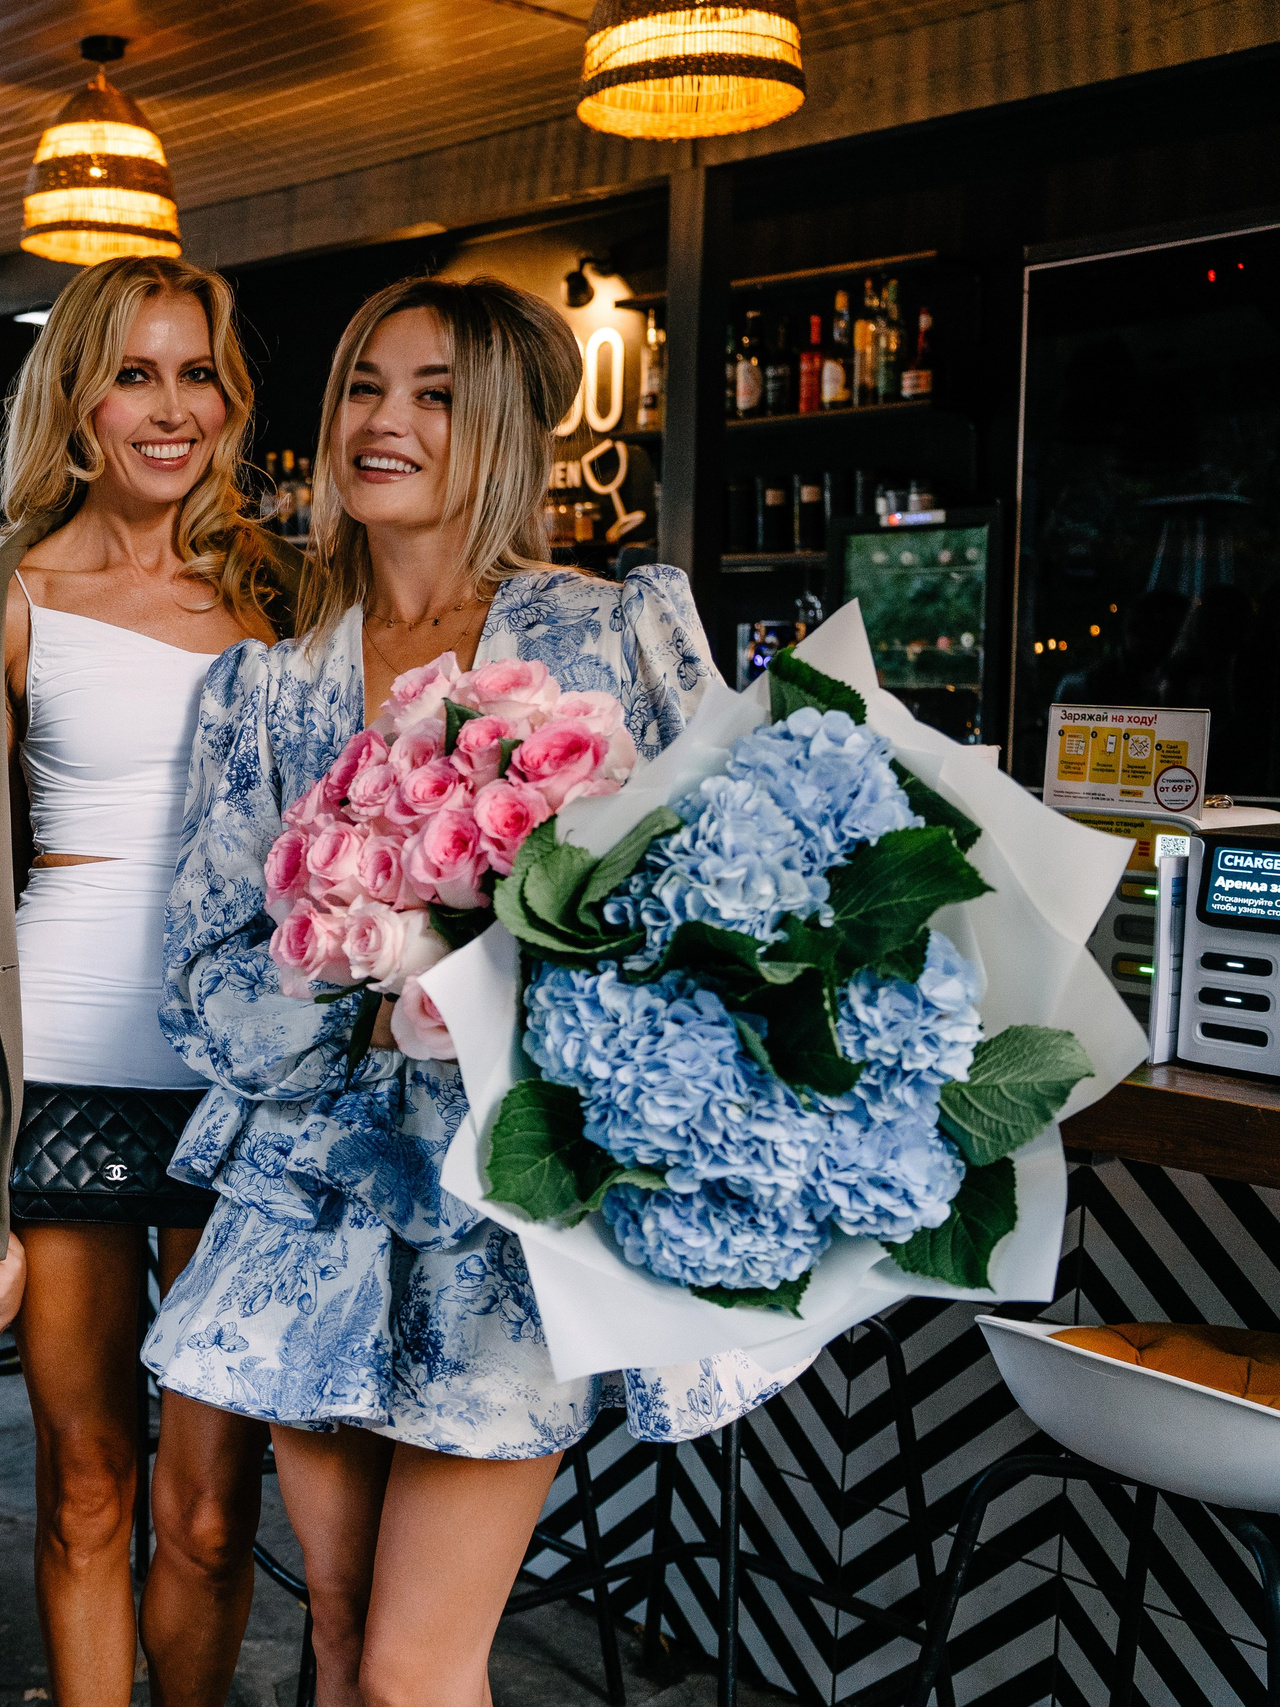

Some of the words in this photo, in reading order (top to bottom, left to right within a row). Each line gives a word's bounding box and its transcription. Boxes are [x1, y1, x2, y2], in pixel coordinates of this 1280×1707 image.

[1060, 709, 1109, 723] Заряжай
[1111, 714, 1124, 723] на
[1127, 713, 1158, 727] ходу!
[1171, 784, 1183, 793] 69
[1224, 855, 1280, 870] CHARGE
[1214, 876, 1268, 893] Аренда
[1213, 893, 1273, 907] Отсканируйте
[1211, 903, 1237, 912] чтобы
[1238, 906, 1266, 915] узнать
